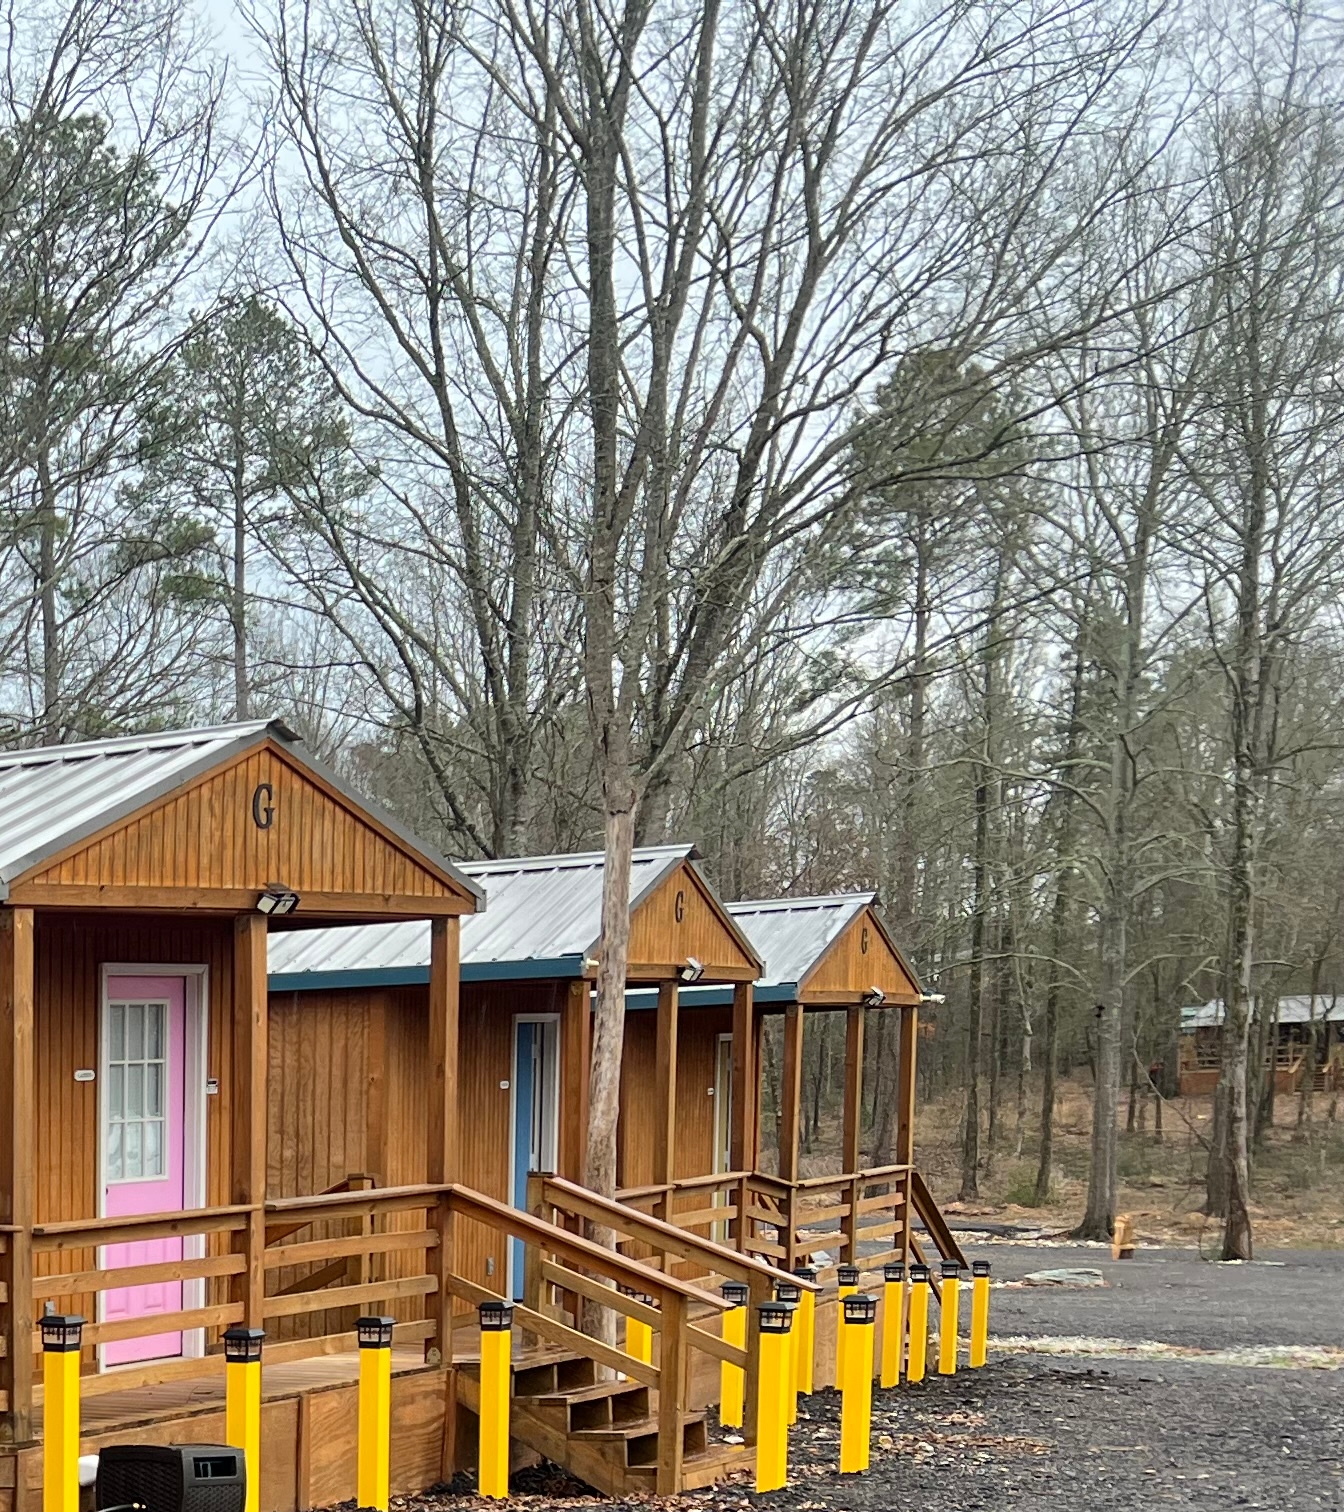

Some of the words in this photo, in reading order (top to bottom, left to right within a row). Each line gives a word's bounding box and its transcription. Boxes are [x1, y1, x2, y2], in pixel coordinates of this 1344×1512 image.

[252, 783, 276, 829] G
[674, 890, 685, 924] G
[860, 927, 869, 955] G
